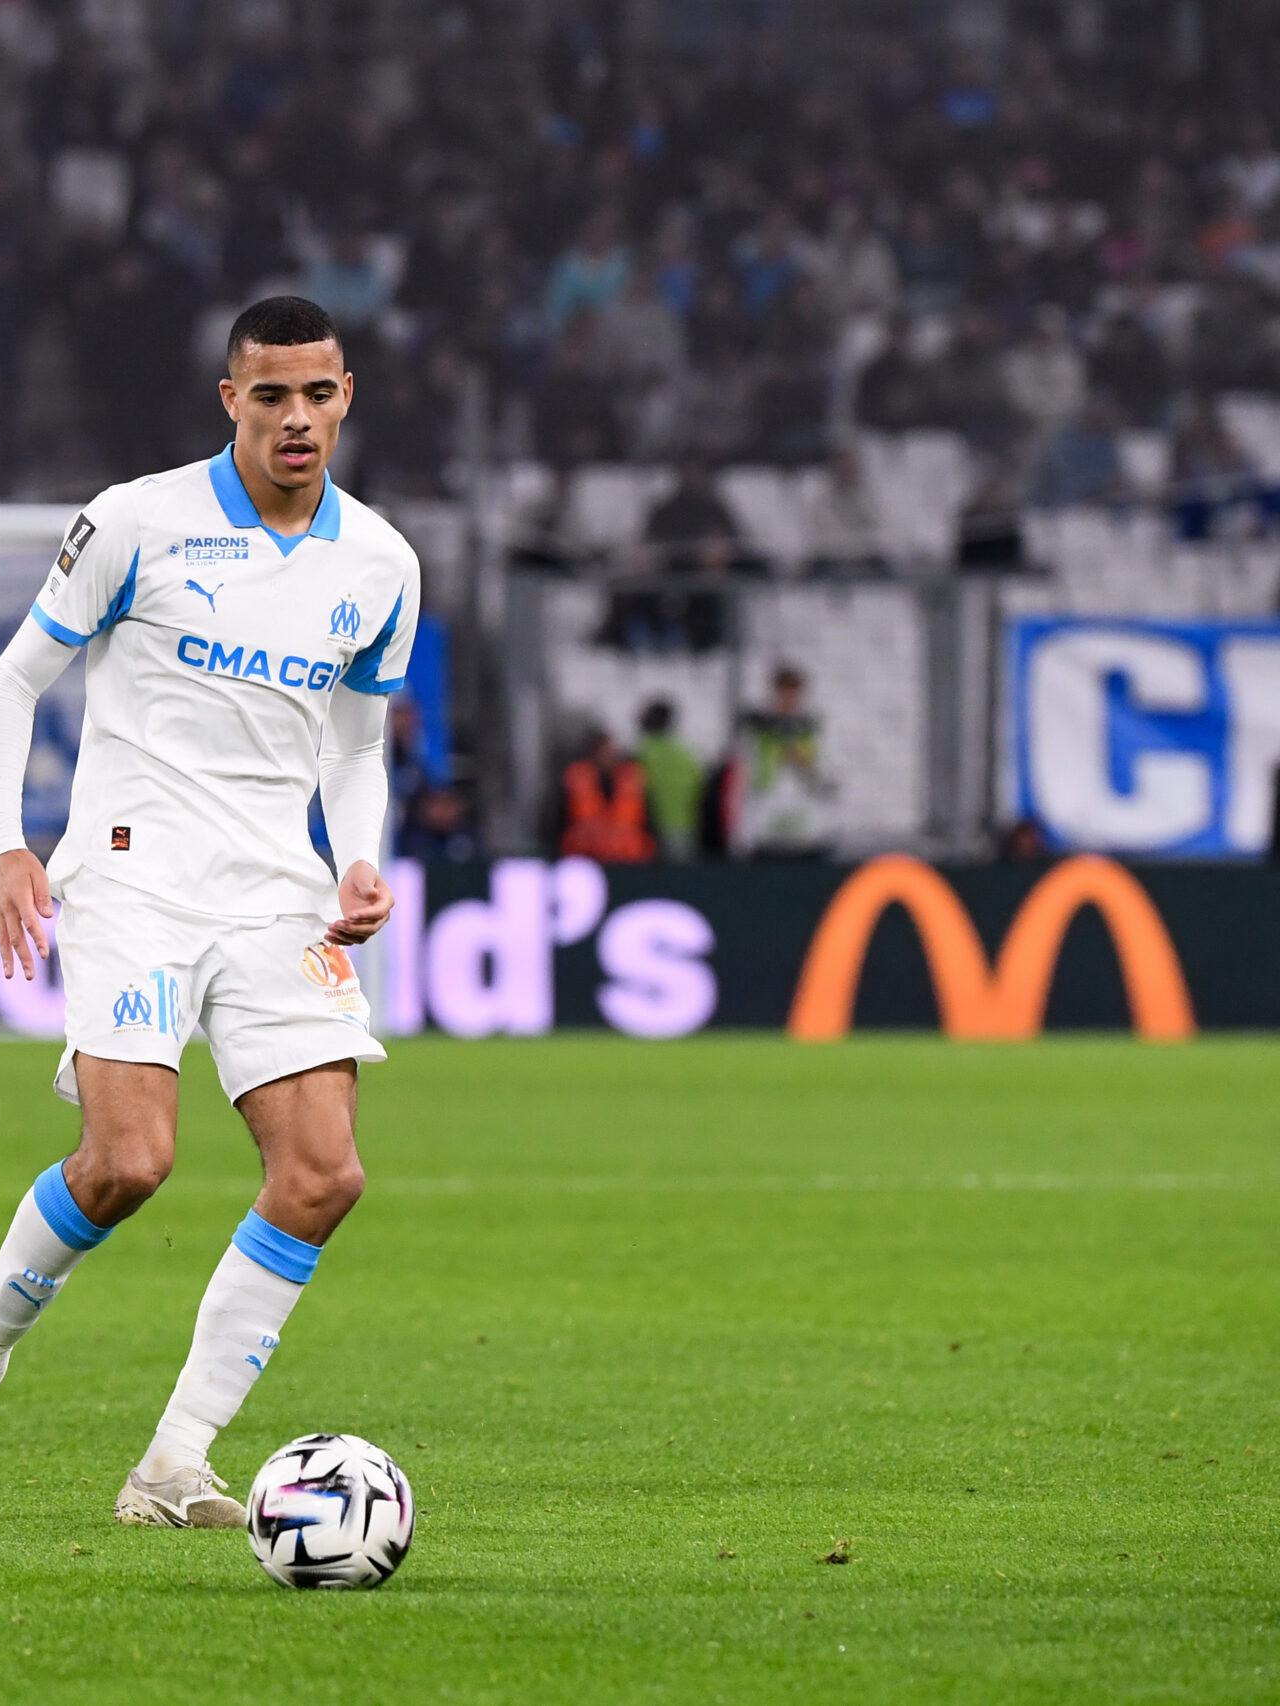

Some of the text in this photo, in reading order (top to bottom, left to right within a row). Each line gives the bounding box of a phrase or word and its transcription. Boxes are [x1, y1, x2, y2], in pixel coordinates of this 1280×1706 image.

[185, 537, 249, 549] PARIONS
[187, 549, 248, 559] SPORT
[177, 635, 271, 682] CMA
[324, 987, 358, 999] SUBLIME
